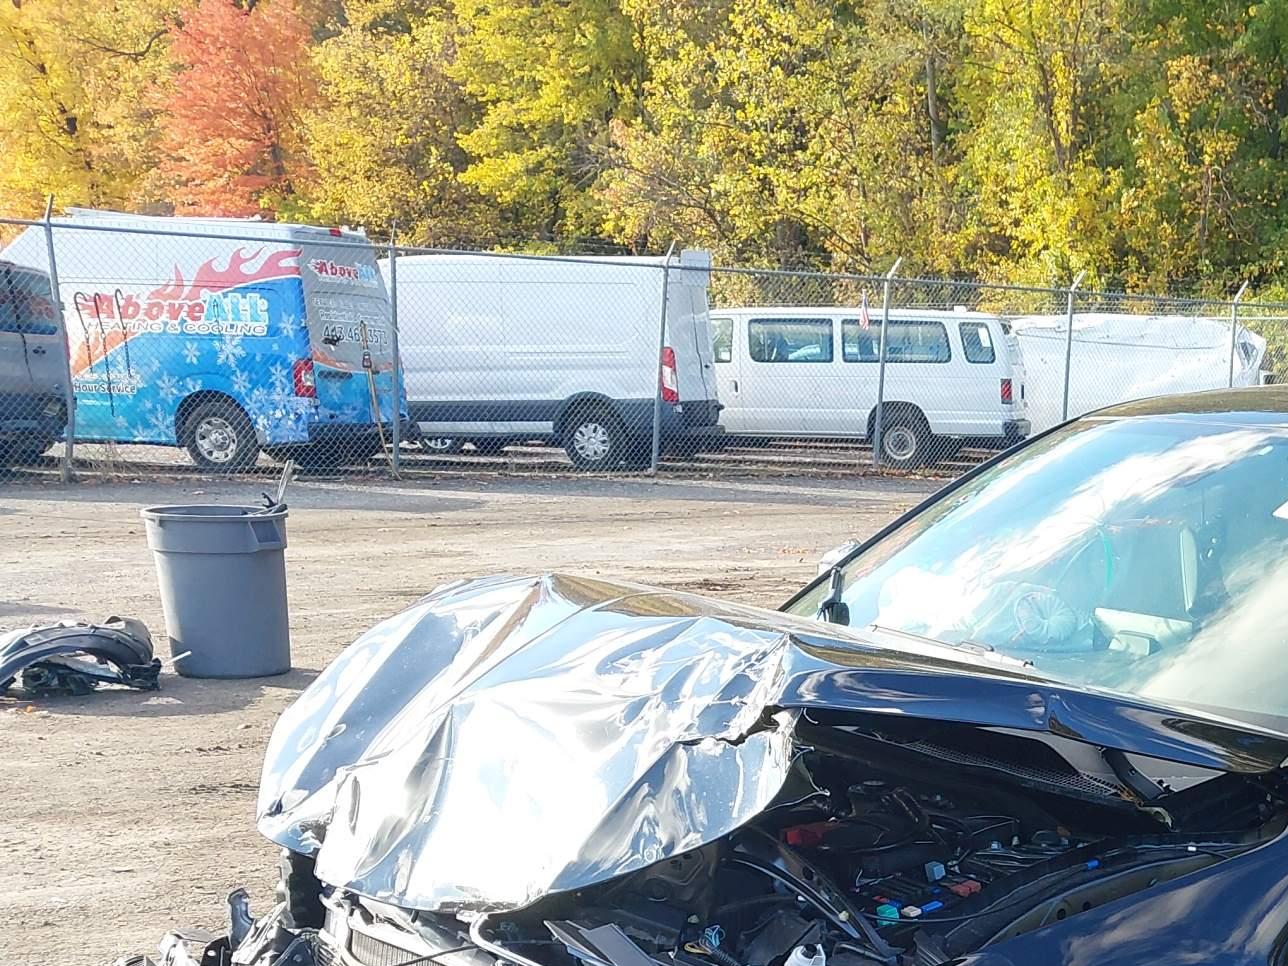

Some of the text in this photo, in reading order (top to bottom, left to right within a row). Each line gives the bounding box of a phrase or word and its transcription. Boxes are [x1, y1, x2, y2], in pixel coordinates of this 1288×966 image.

[87, 320, 266, 335] HEATING & COOLING
[74, 383, 98, 393] Hour
